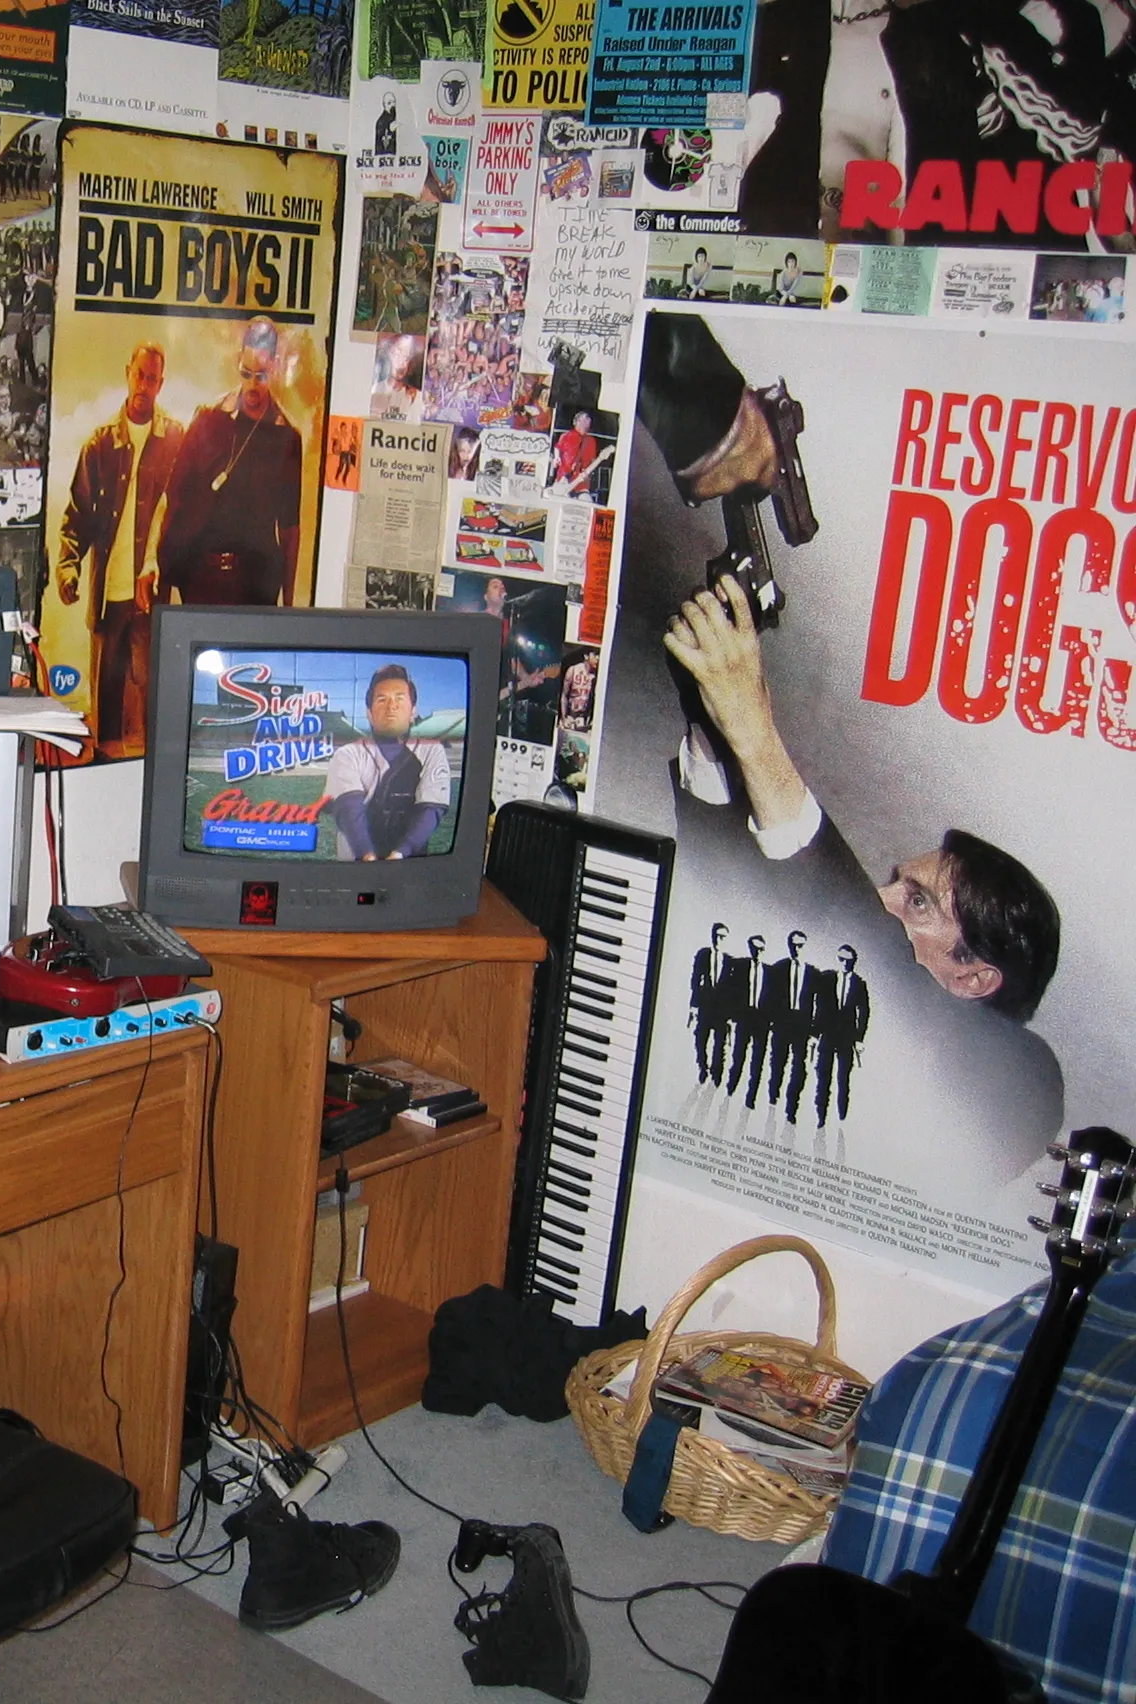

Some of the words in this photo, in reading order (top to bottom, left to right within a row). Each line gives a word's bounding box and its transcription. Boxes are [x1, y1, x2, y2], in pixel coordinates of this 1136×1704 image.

[118, 1, 142, 18] Sails
[144, 7, 154, 20] in
[156, 9, 172, 22] the
[174, 12, 205, 29] Sunset
[627, 7, 659, 32] THE
[661, 5, 744, 31] ARRIVALS
[19, 31, 51, 47] mouth
[603, 37, 646, 53] Raised
[648, 37, 687, 52] Under
[690, 36, 737, 53] Reagan
[542, 48, 554, 64] IS
[491, 69, 519, 104] TO
[144, 99, 155, 112] LP
[481, 118, 535, 146] JIMMY'S
[575, 126, 630, 142] RANCID
[475, 146, 532, 170] PARKING
[485, 171, 519, 196] ONLY
[78, 172, 137, 201] MARTIN
[142, 180, 218, 210] LAWRENCE
[246, 191, 277, 217] WILL
[281, 196, 323, 222] SMITH
[476, 200, 493, 208] ALL
[494, 200, 524, 208] OTHERS
[840, 158, 1136, 235] RANCI
[472, 208, 487, 217] WILL
[655, 214, 675, 230] the
[679, 214, 741, 232] Commodes
[558, 226, 616, 243] BREAK
[75, 215, 165, 300] BAD
[176, 225, 282, 307] BOYS
[286, 236, 314, 310] II
[370, 428, 438, 454] Rancid
[370, 458, 390, 469] Life
[390, 460, 414, 471] does
[415, 463, 436, 474] wait
[379, 470, 392, 480] for
[394, 470, 425, 483] them!
[55, 670, 76, 691] fye
[197, 662, 328, 727] Sign
[253, 713, 323, 746] AND
[224, 732, 335, 783] DRIVE!
[203, 788, 336, 824] Grand
[209, 825, 257, 835] PONTIAC
[268, 829, 309, 837] BUICK
[236, 836, 268, 845] GMC
[954, 1212, 987, 1229] QUENTIN
[988, 1222, 1029, 1242] TARANTINO
